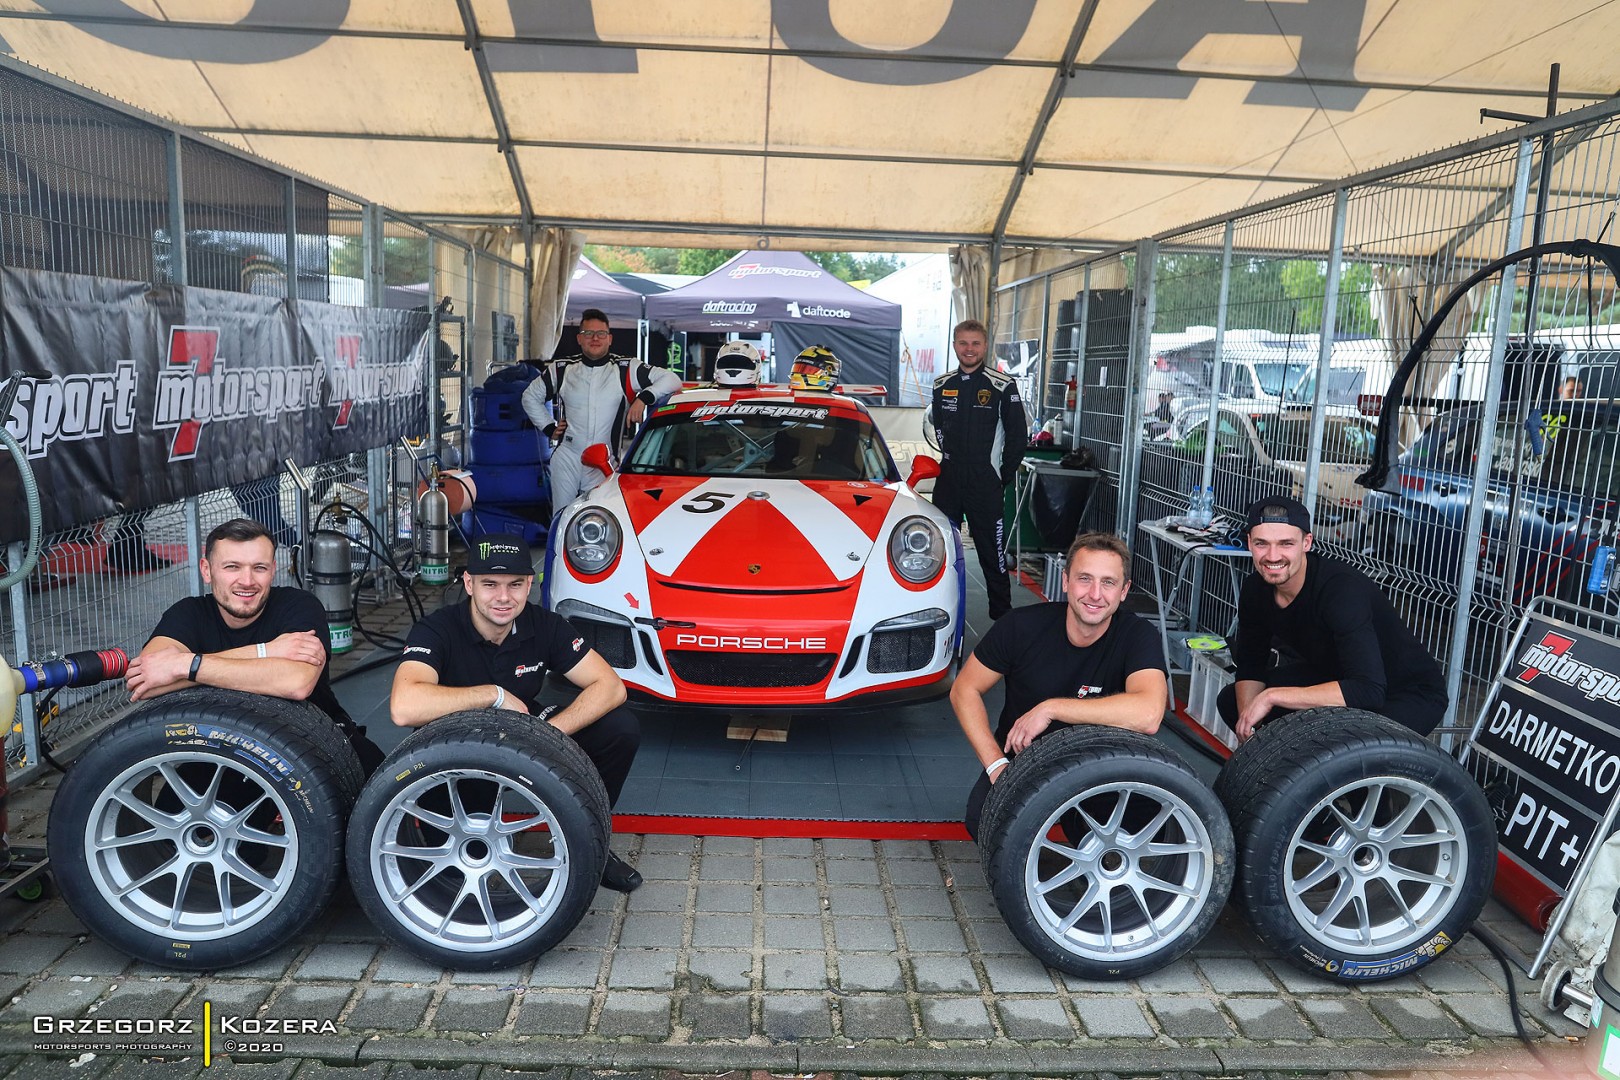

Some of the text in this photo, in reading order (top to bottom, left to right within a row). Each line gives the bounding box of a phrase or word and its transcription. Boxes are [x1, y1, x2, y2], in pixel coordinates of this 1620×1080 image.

[702, 300, 757, 315] daftracing
[802, 306, 851, 319] daftcode
[153, 357, 326, 424] motorsport
[327, 358, 424, 406] motorsport
[690, 404, 829, 420] motorsport
[682, 492, 735, 514] 5
[996, 518, 1005, 574] PERTAMINA
[330, 631, 352, 639] ITRO
[676, 634, 827, 649] PORSCHE
[209, 730, 288, 773] MICHELIN
[1488, 700, 1620, 794] DARMETKO
[1504, 792, 1580, 867] PIT+
[1343, 958, 1418, 976] MICHELIN
